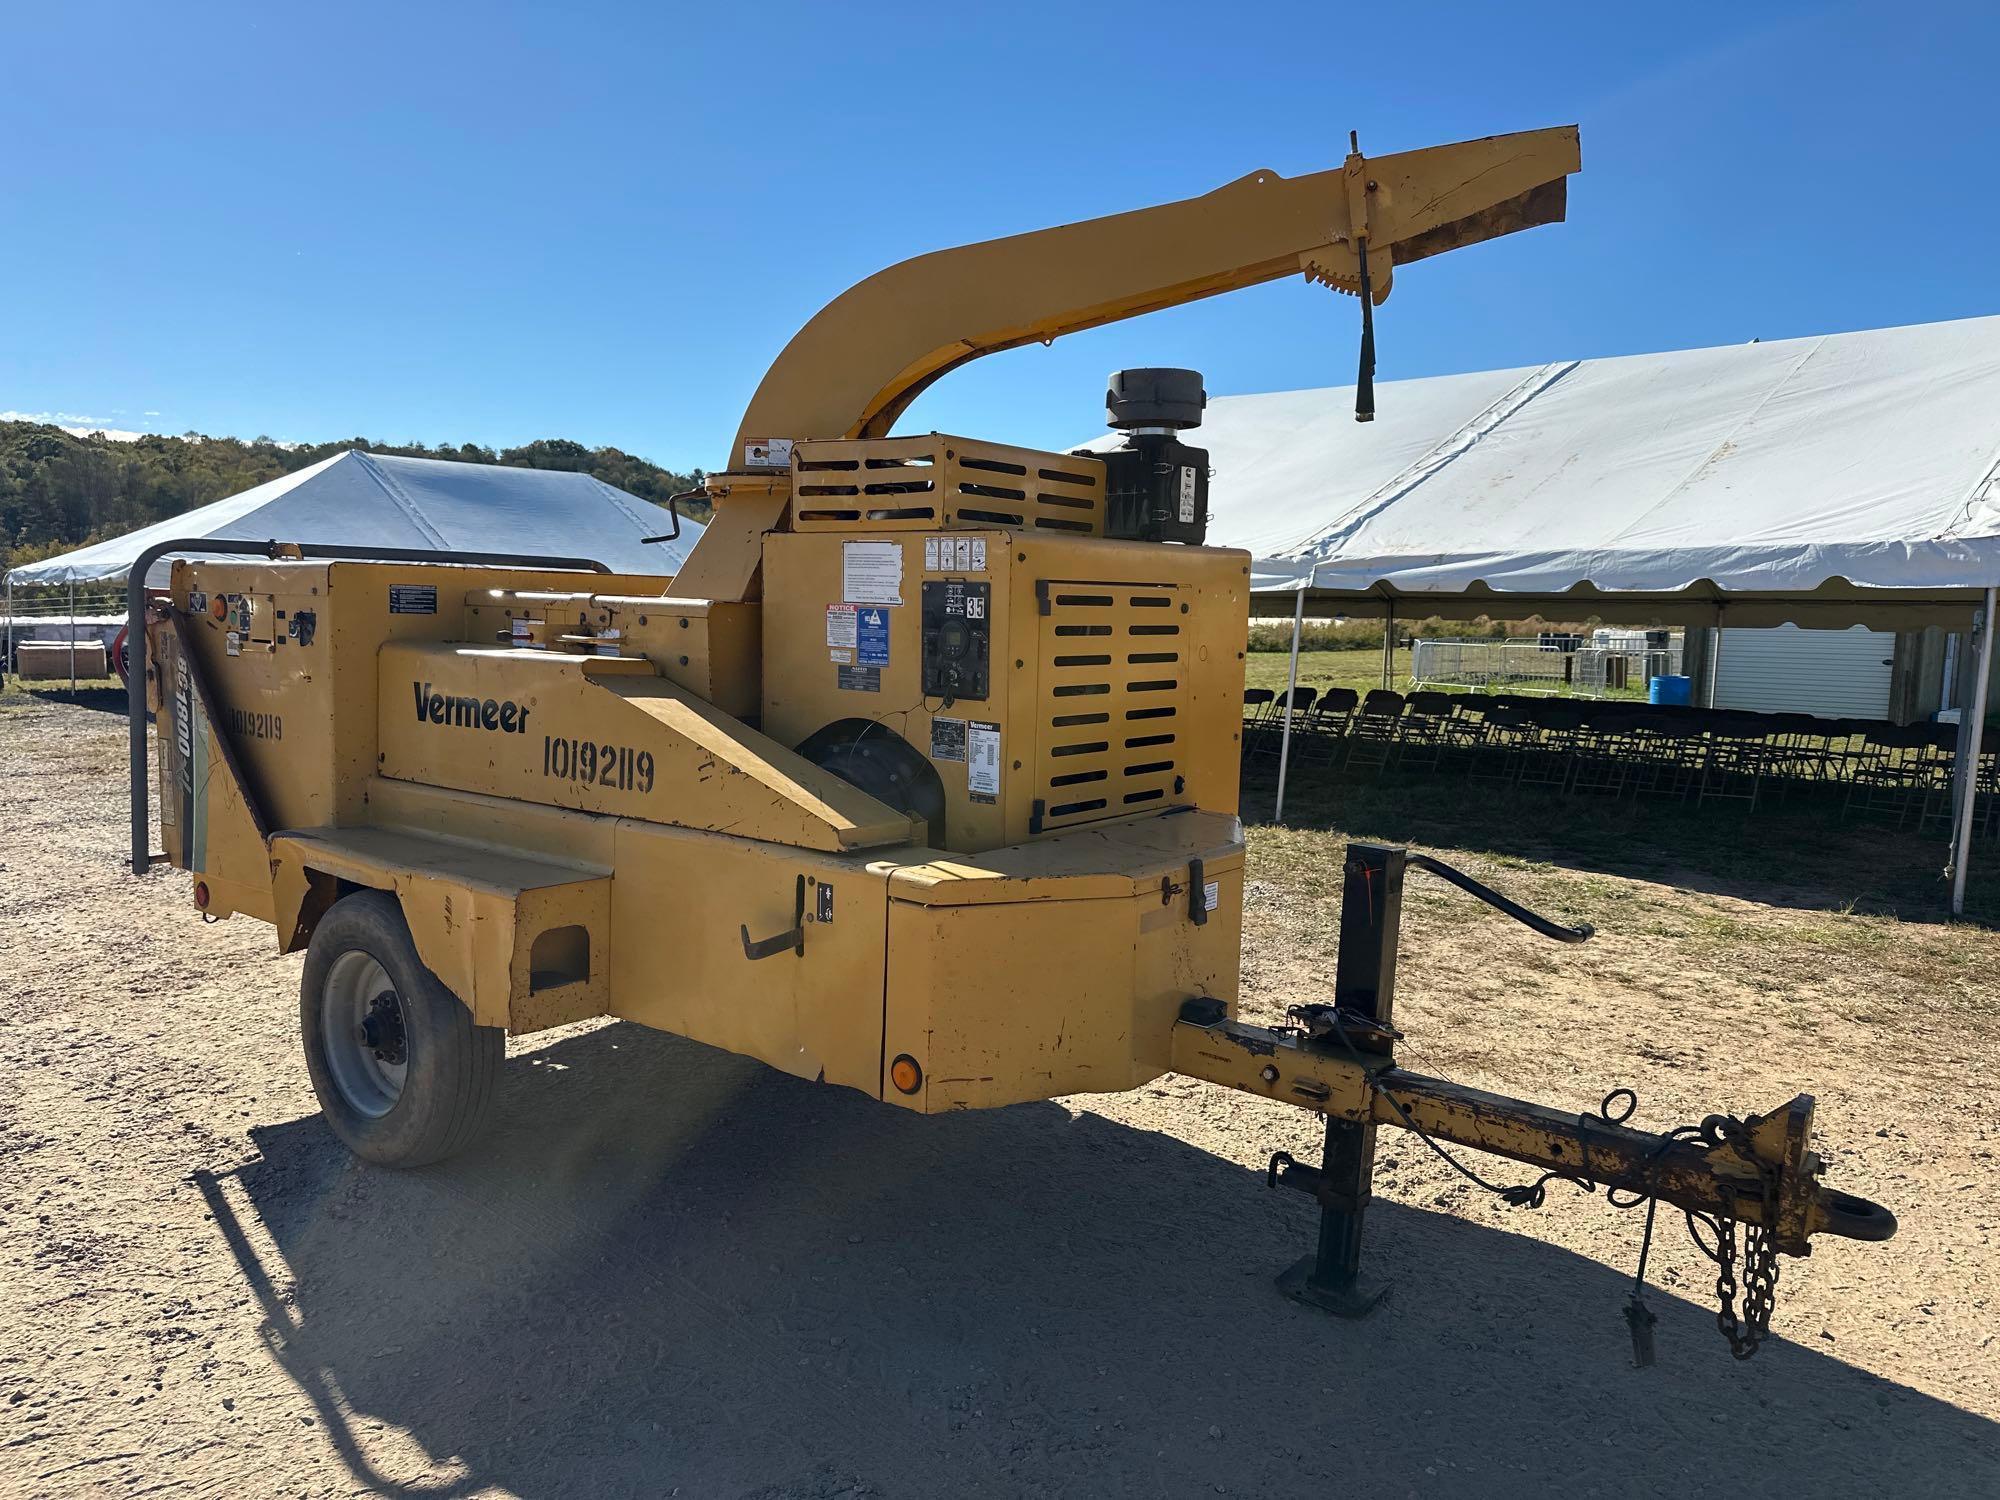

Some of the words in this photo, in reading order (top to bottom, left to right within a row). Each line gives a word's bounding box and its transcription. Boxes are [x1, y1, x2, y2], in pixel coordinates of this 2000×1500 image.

[829, 604, 855, 612] NOTICE
[968, 598, 983, 617] 35
[413, 681, 530, 734] Vermeer
[230, 707, 282, 741] 10192119
[970, 721, 993, 731] Vermeer
[543, 735, 655, 794] 10192119
